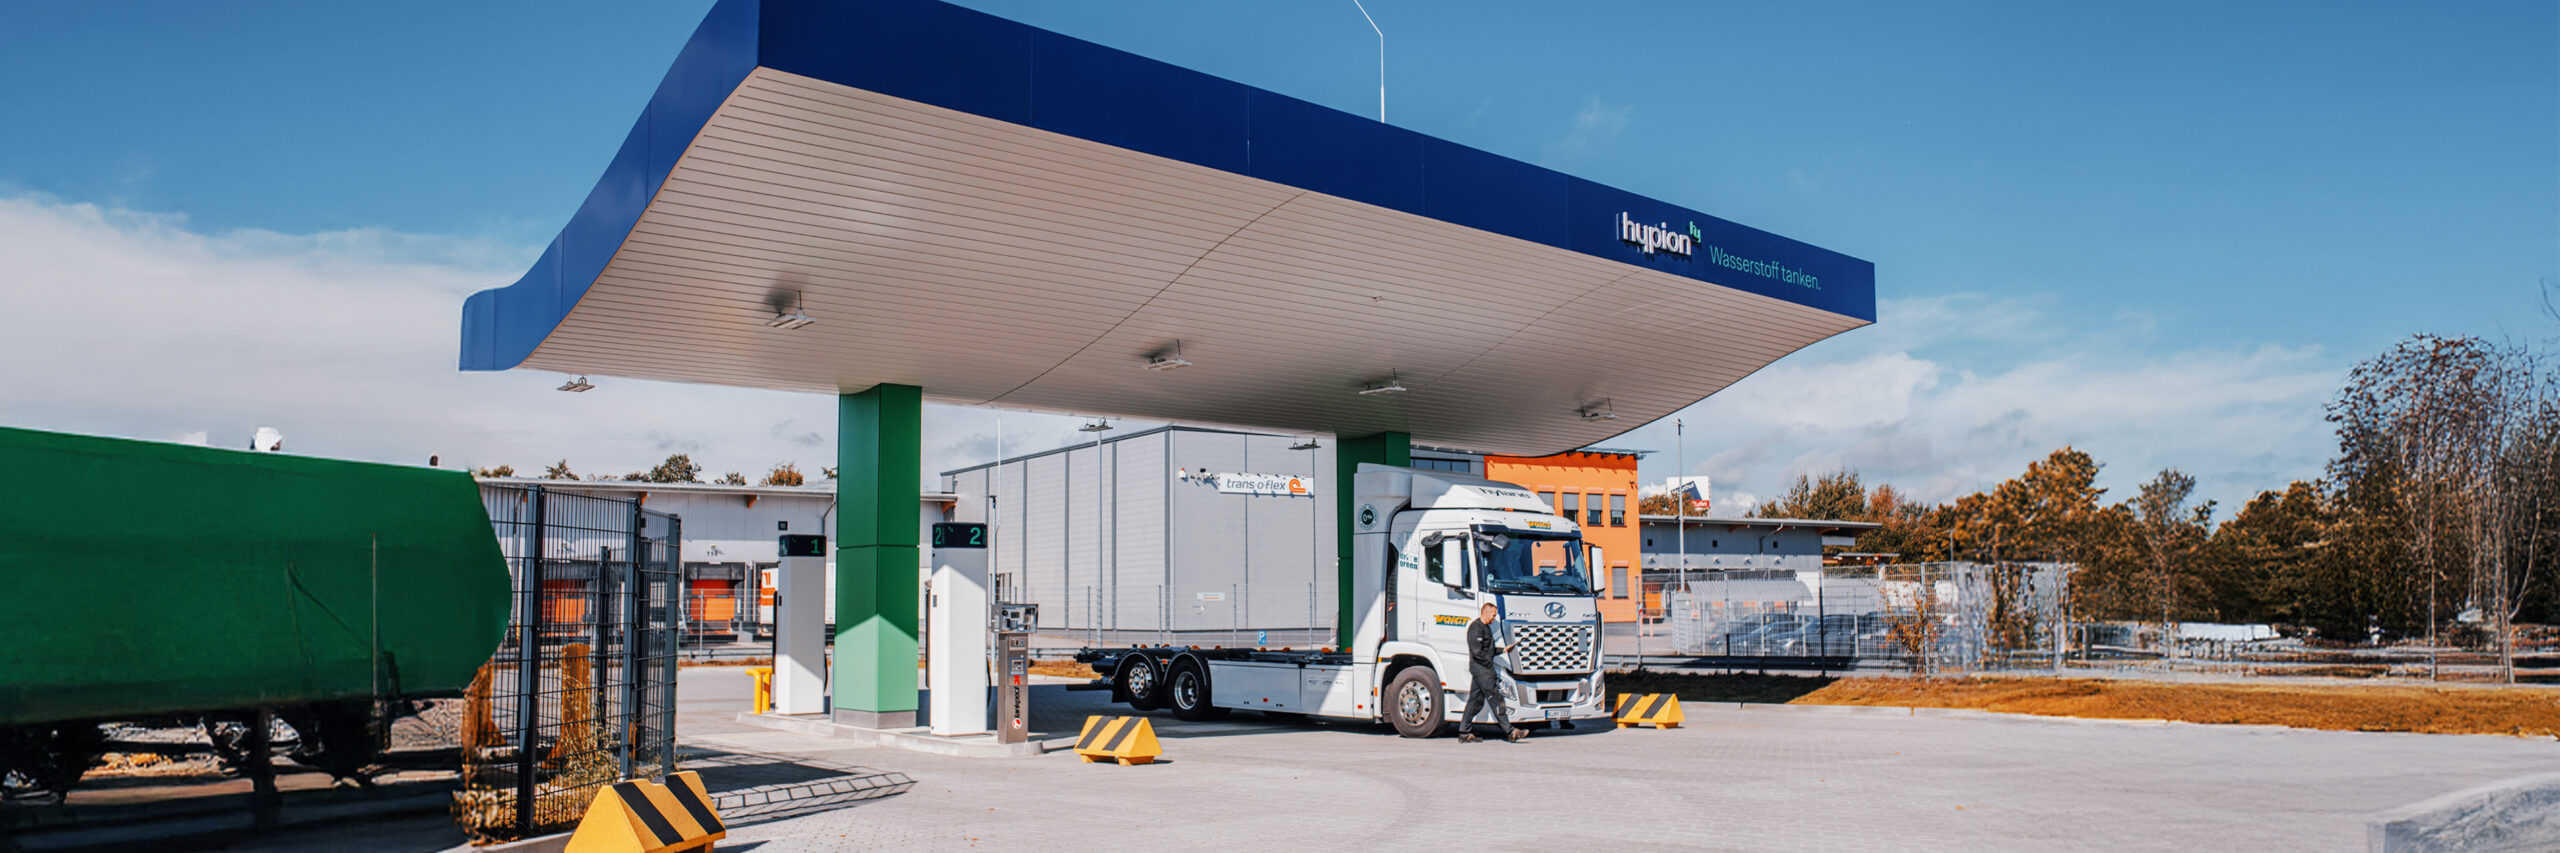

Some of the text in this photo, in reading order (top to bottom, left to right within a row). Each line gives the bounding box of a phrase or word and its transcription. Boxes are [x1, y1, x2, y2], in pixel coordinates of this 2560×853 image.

[1622, 211, 1702, 255] hypion hy
[1709, 244, 1822, 291] Wasserstoff tanken.
[1227, 478, 1255, 489] trans
[1265, 480, 1286, 491] flex
[935, 526, 942, 545] 2
[969, 526, 981, 545] 2
[810, 538, 821, 554] 1
[1400, 560, 1418, 570] green
[1433, 613, 1472, 625] VOIGT
